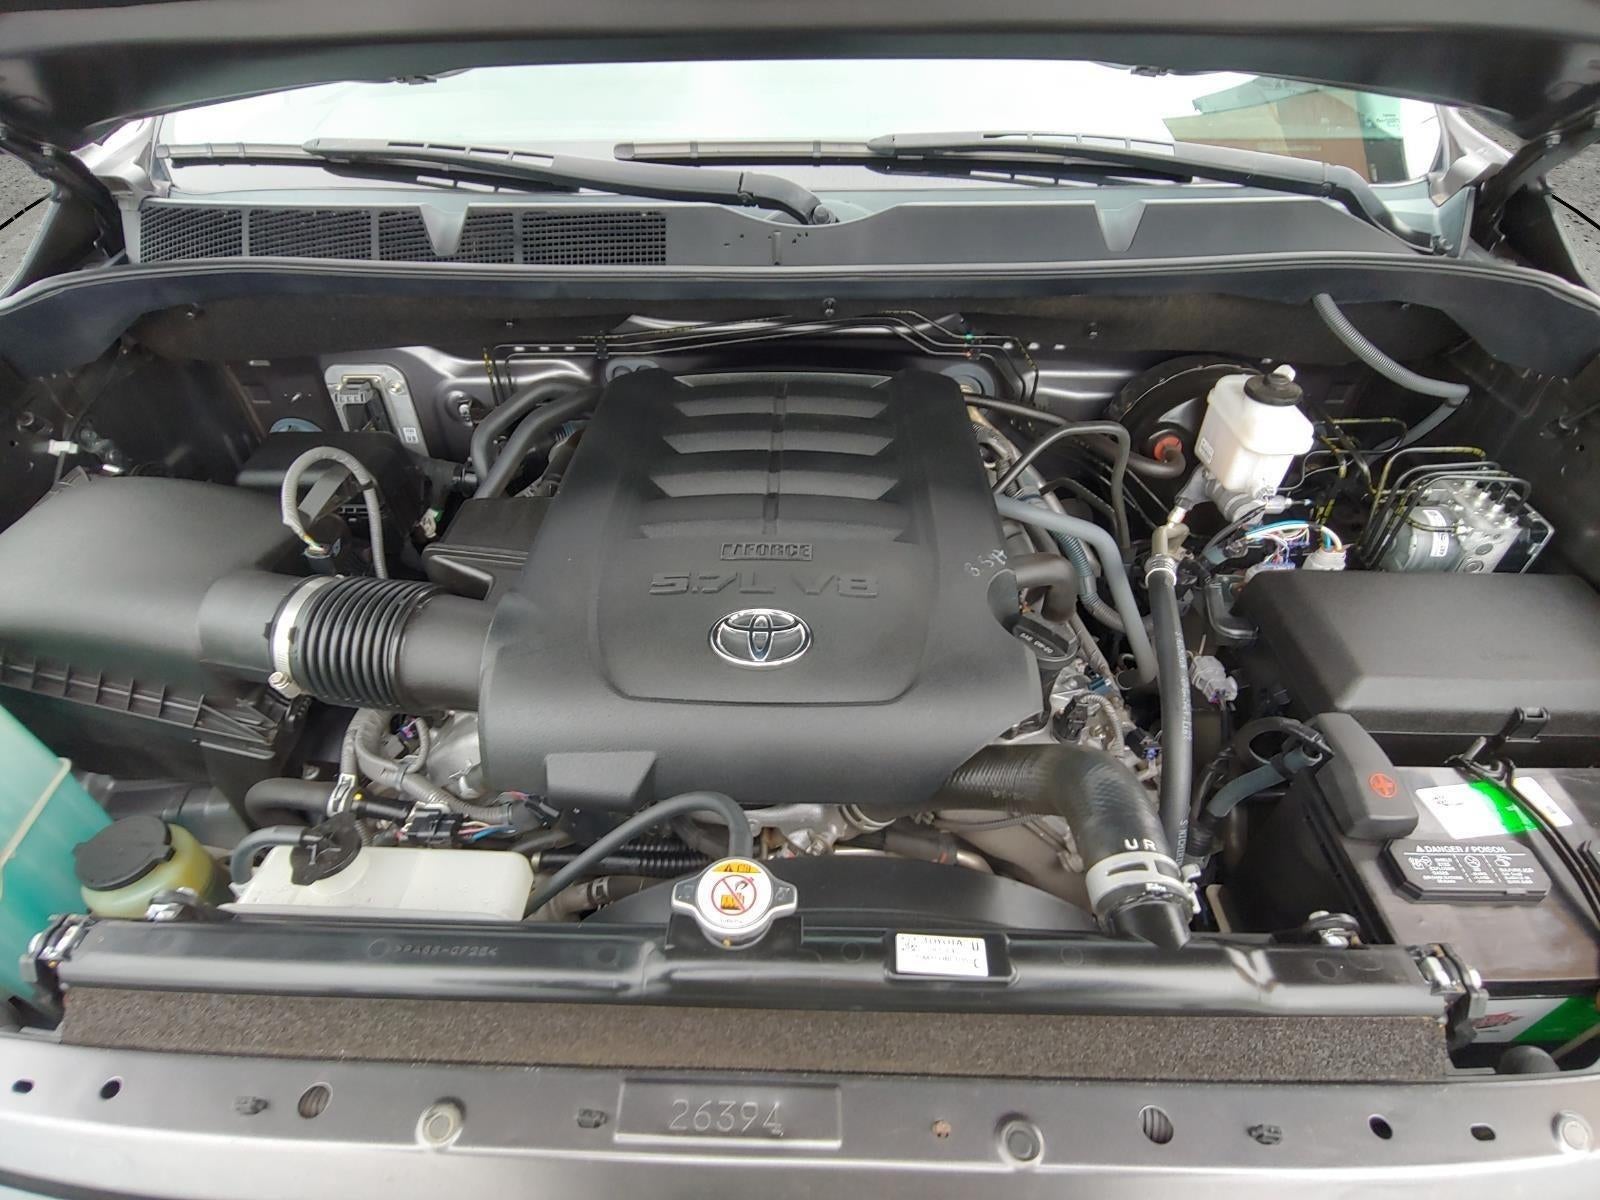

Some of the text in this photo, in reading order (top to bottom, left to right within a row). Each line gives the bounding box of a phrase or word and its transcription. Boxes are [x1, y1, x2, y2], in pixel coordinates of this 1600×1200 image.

[790, 574, 879, 599] V8
[1423, 845, 1464, 853] DANGER
[1471, 845, 1507, 853] POISON
[668, 1098, 784, 1136] 26394
